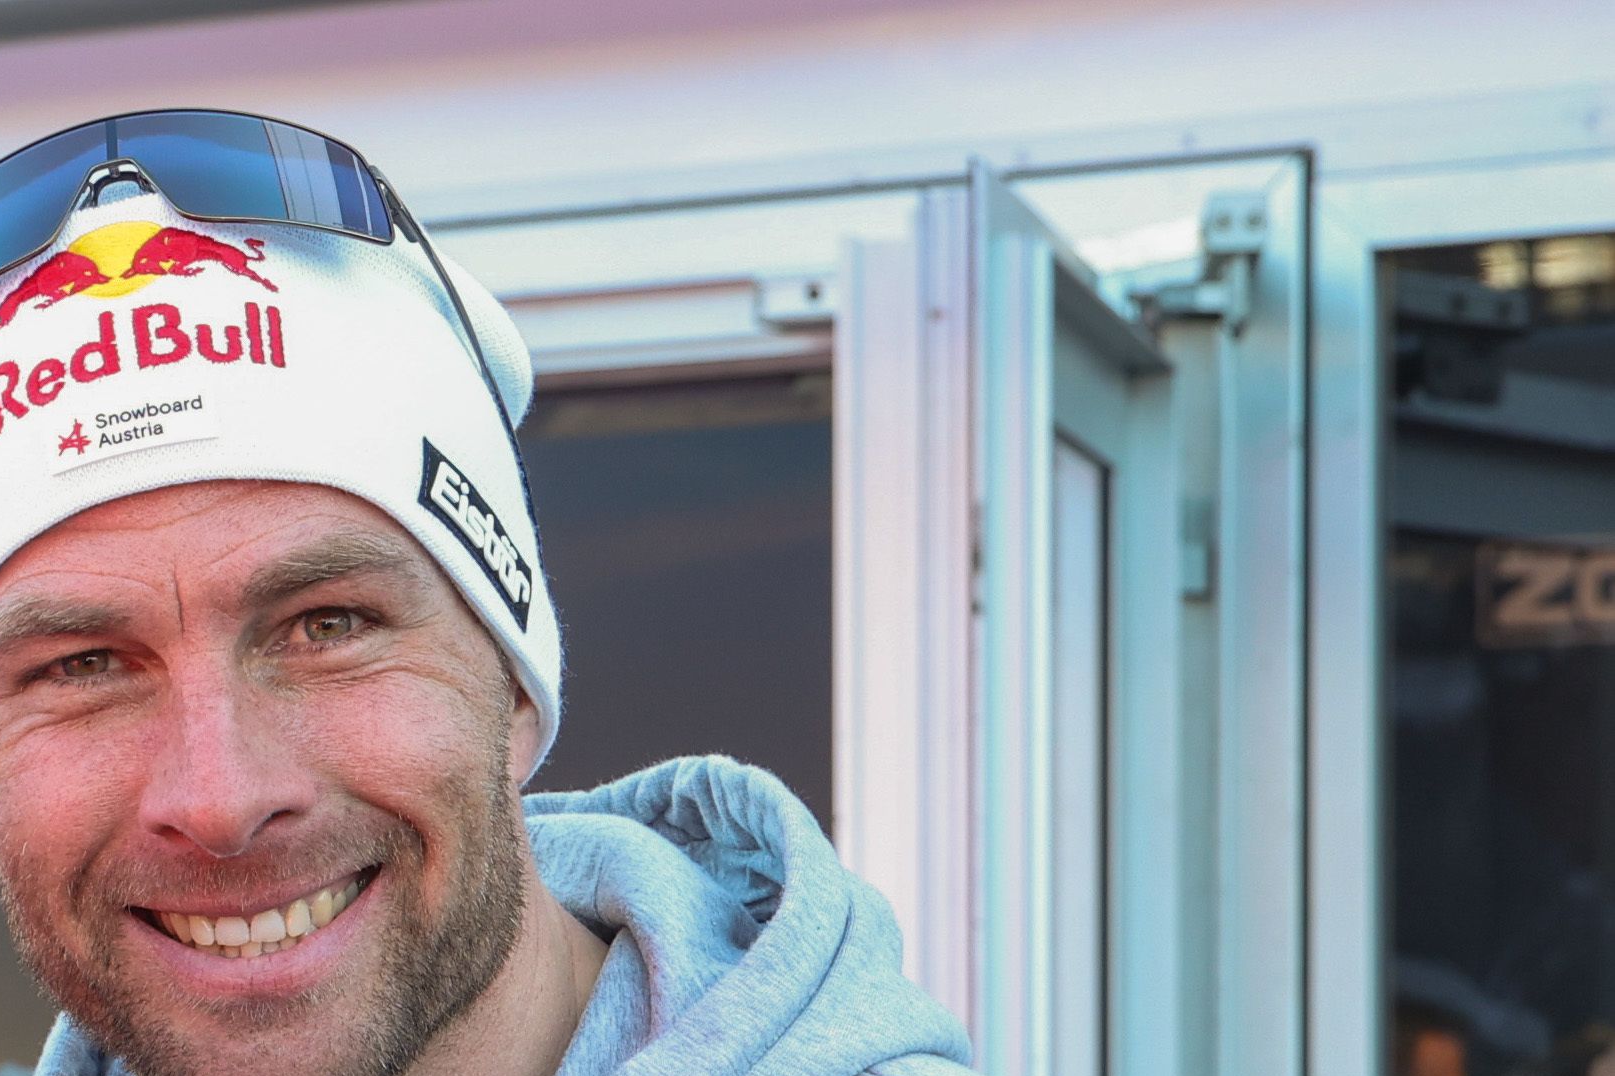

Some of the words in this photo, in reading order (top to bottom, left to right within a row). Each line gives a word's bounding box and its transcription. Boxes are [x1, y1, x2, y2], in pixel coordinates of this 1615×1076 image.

[132, 302, 286, 369] Bull
[95, 395, 203, 430] Snowboard
[98, 422, 164, 448] Austria
